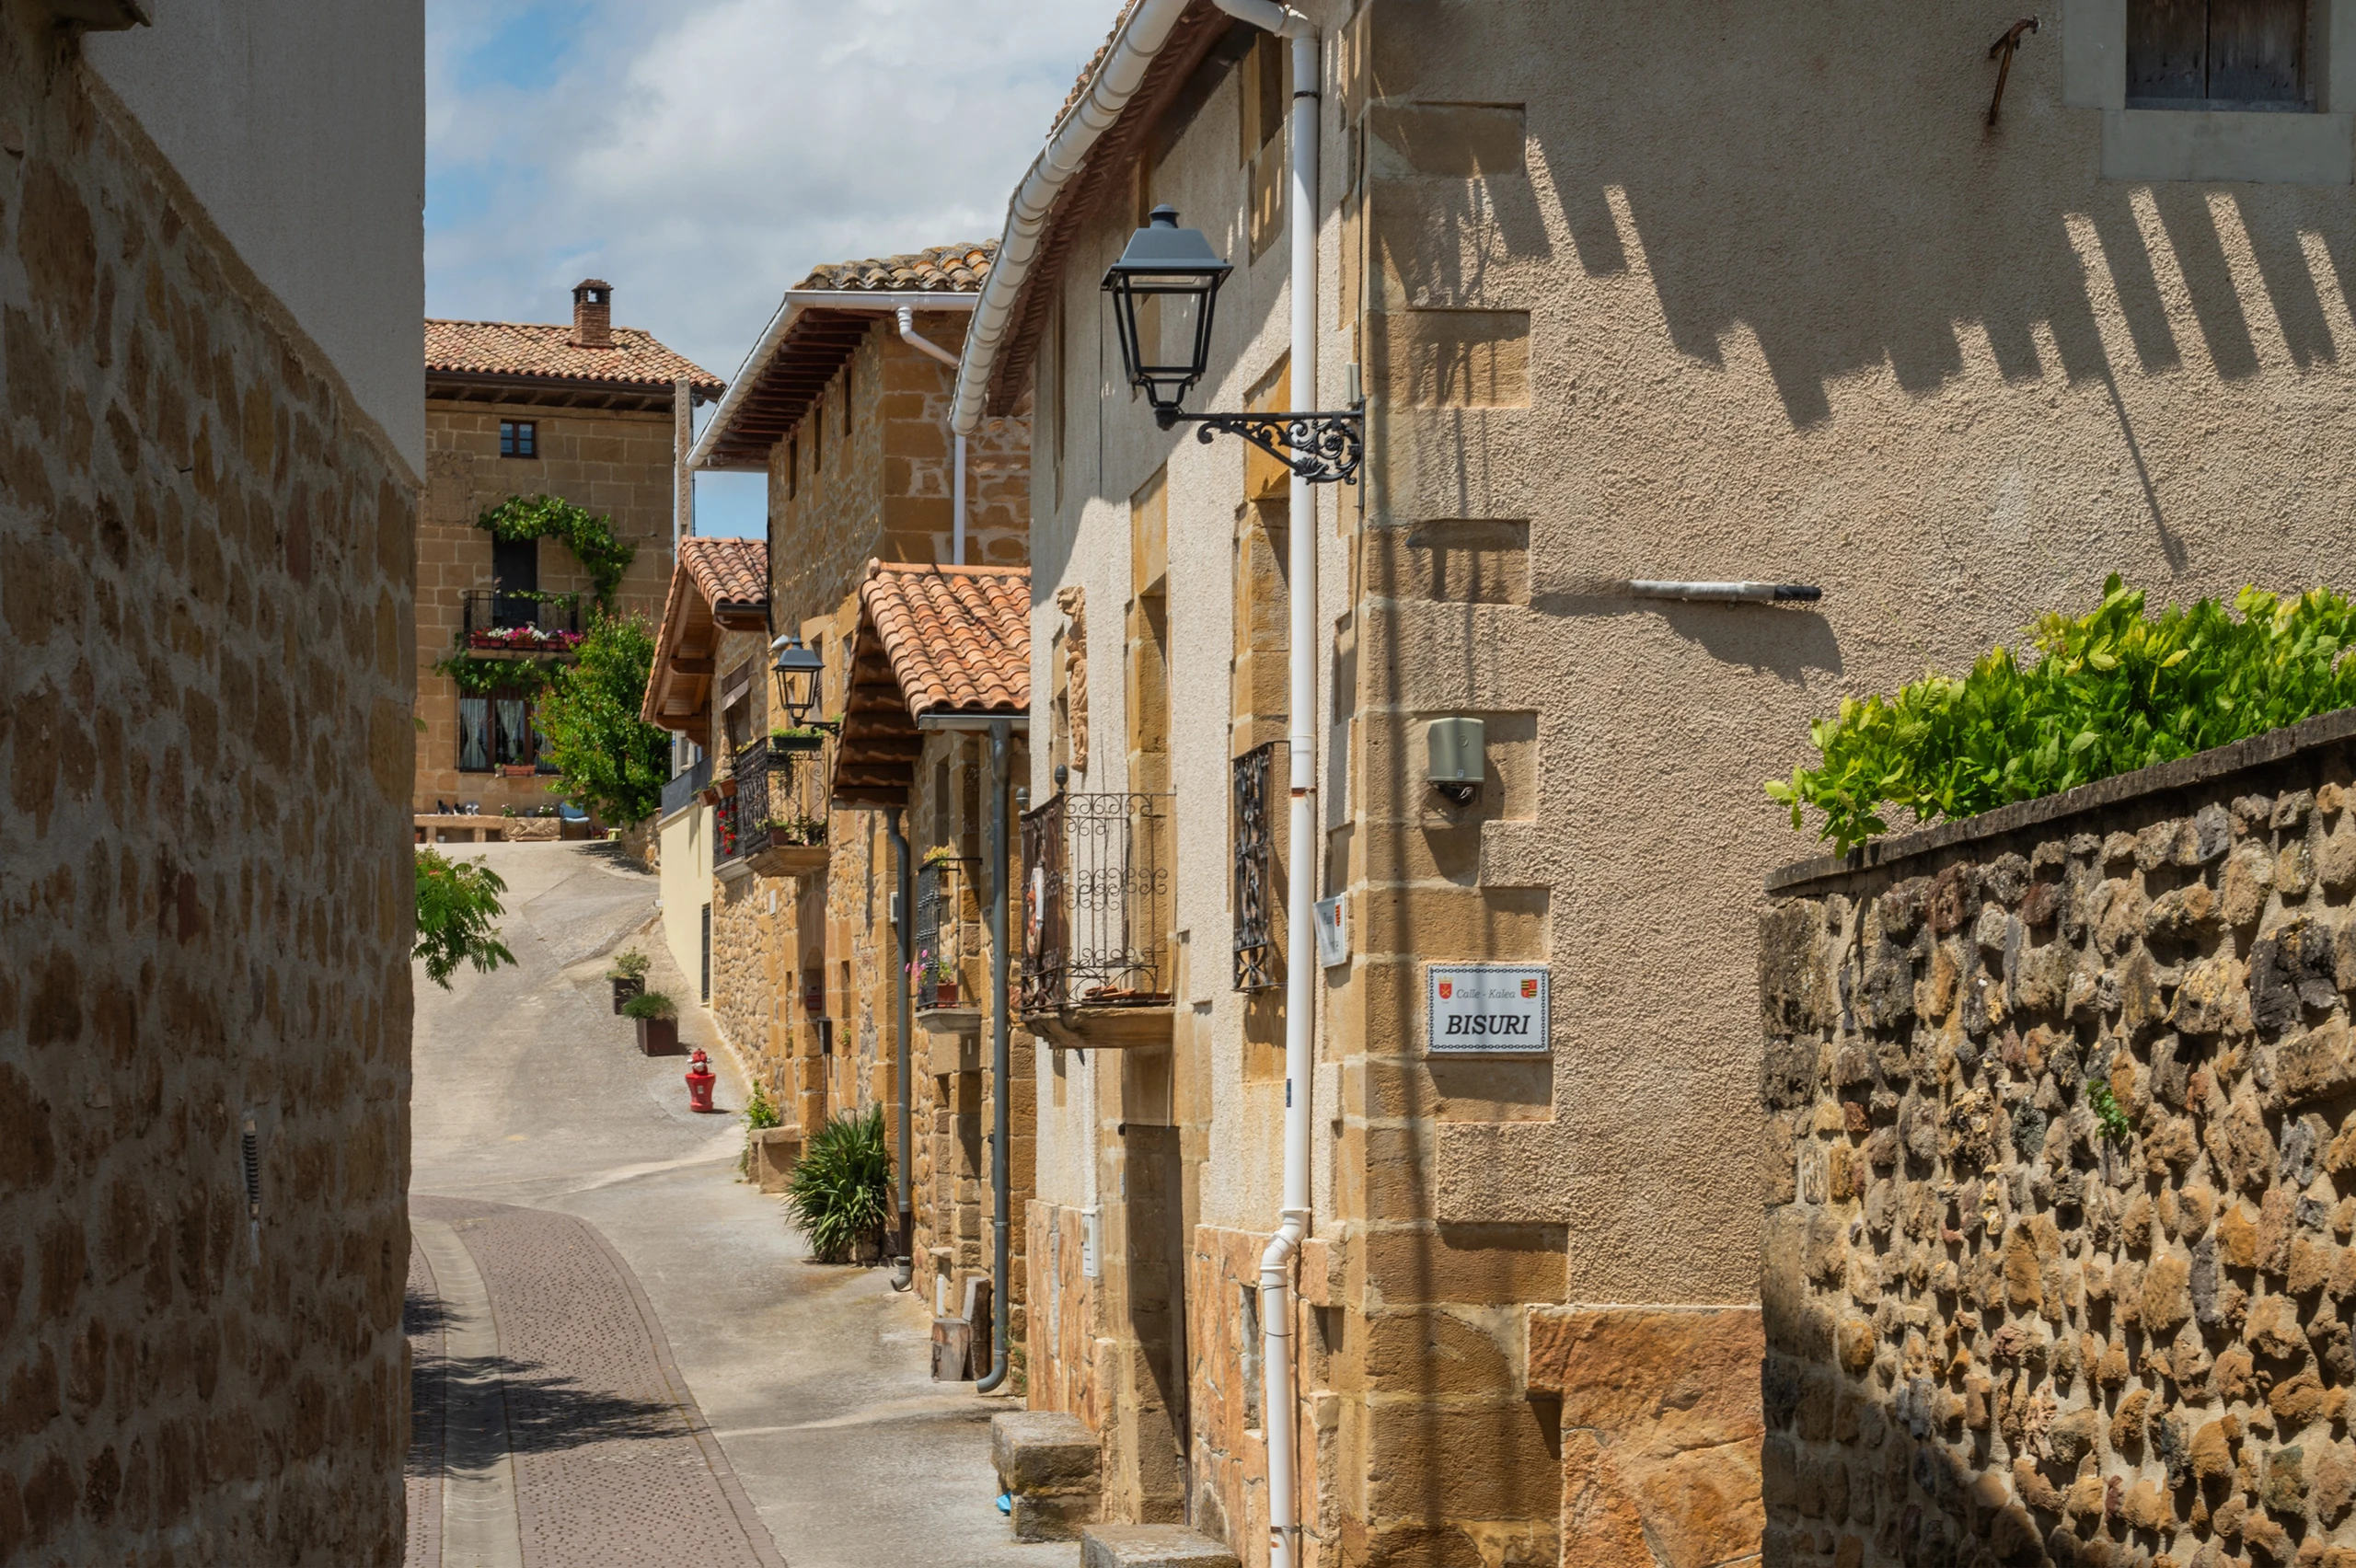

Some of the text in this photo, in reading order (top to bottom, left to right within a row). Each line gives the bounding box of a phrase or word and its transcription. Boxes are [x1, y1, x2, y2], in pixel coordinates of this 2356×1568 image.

[1456, 988, 1481, 999] Calle
[1488, 988, 1516, 999] Kalea
[1445, 1015, 1530, 1035] BISURI
